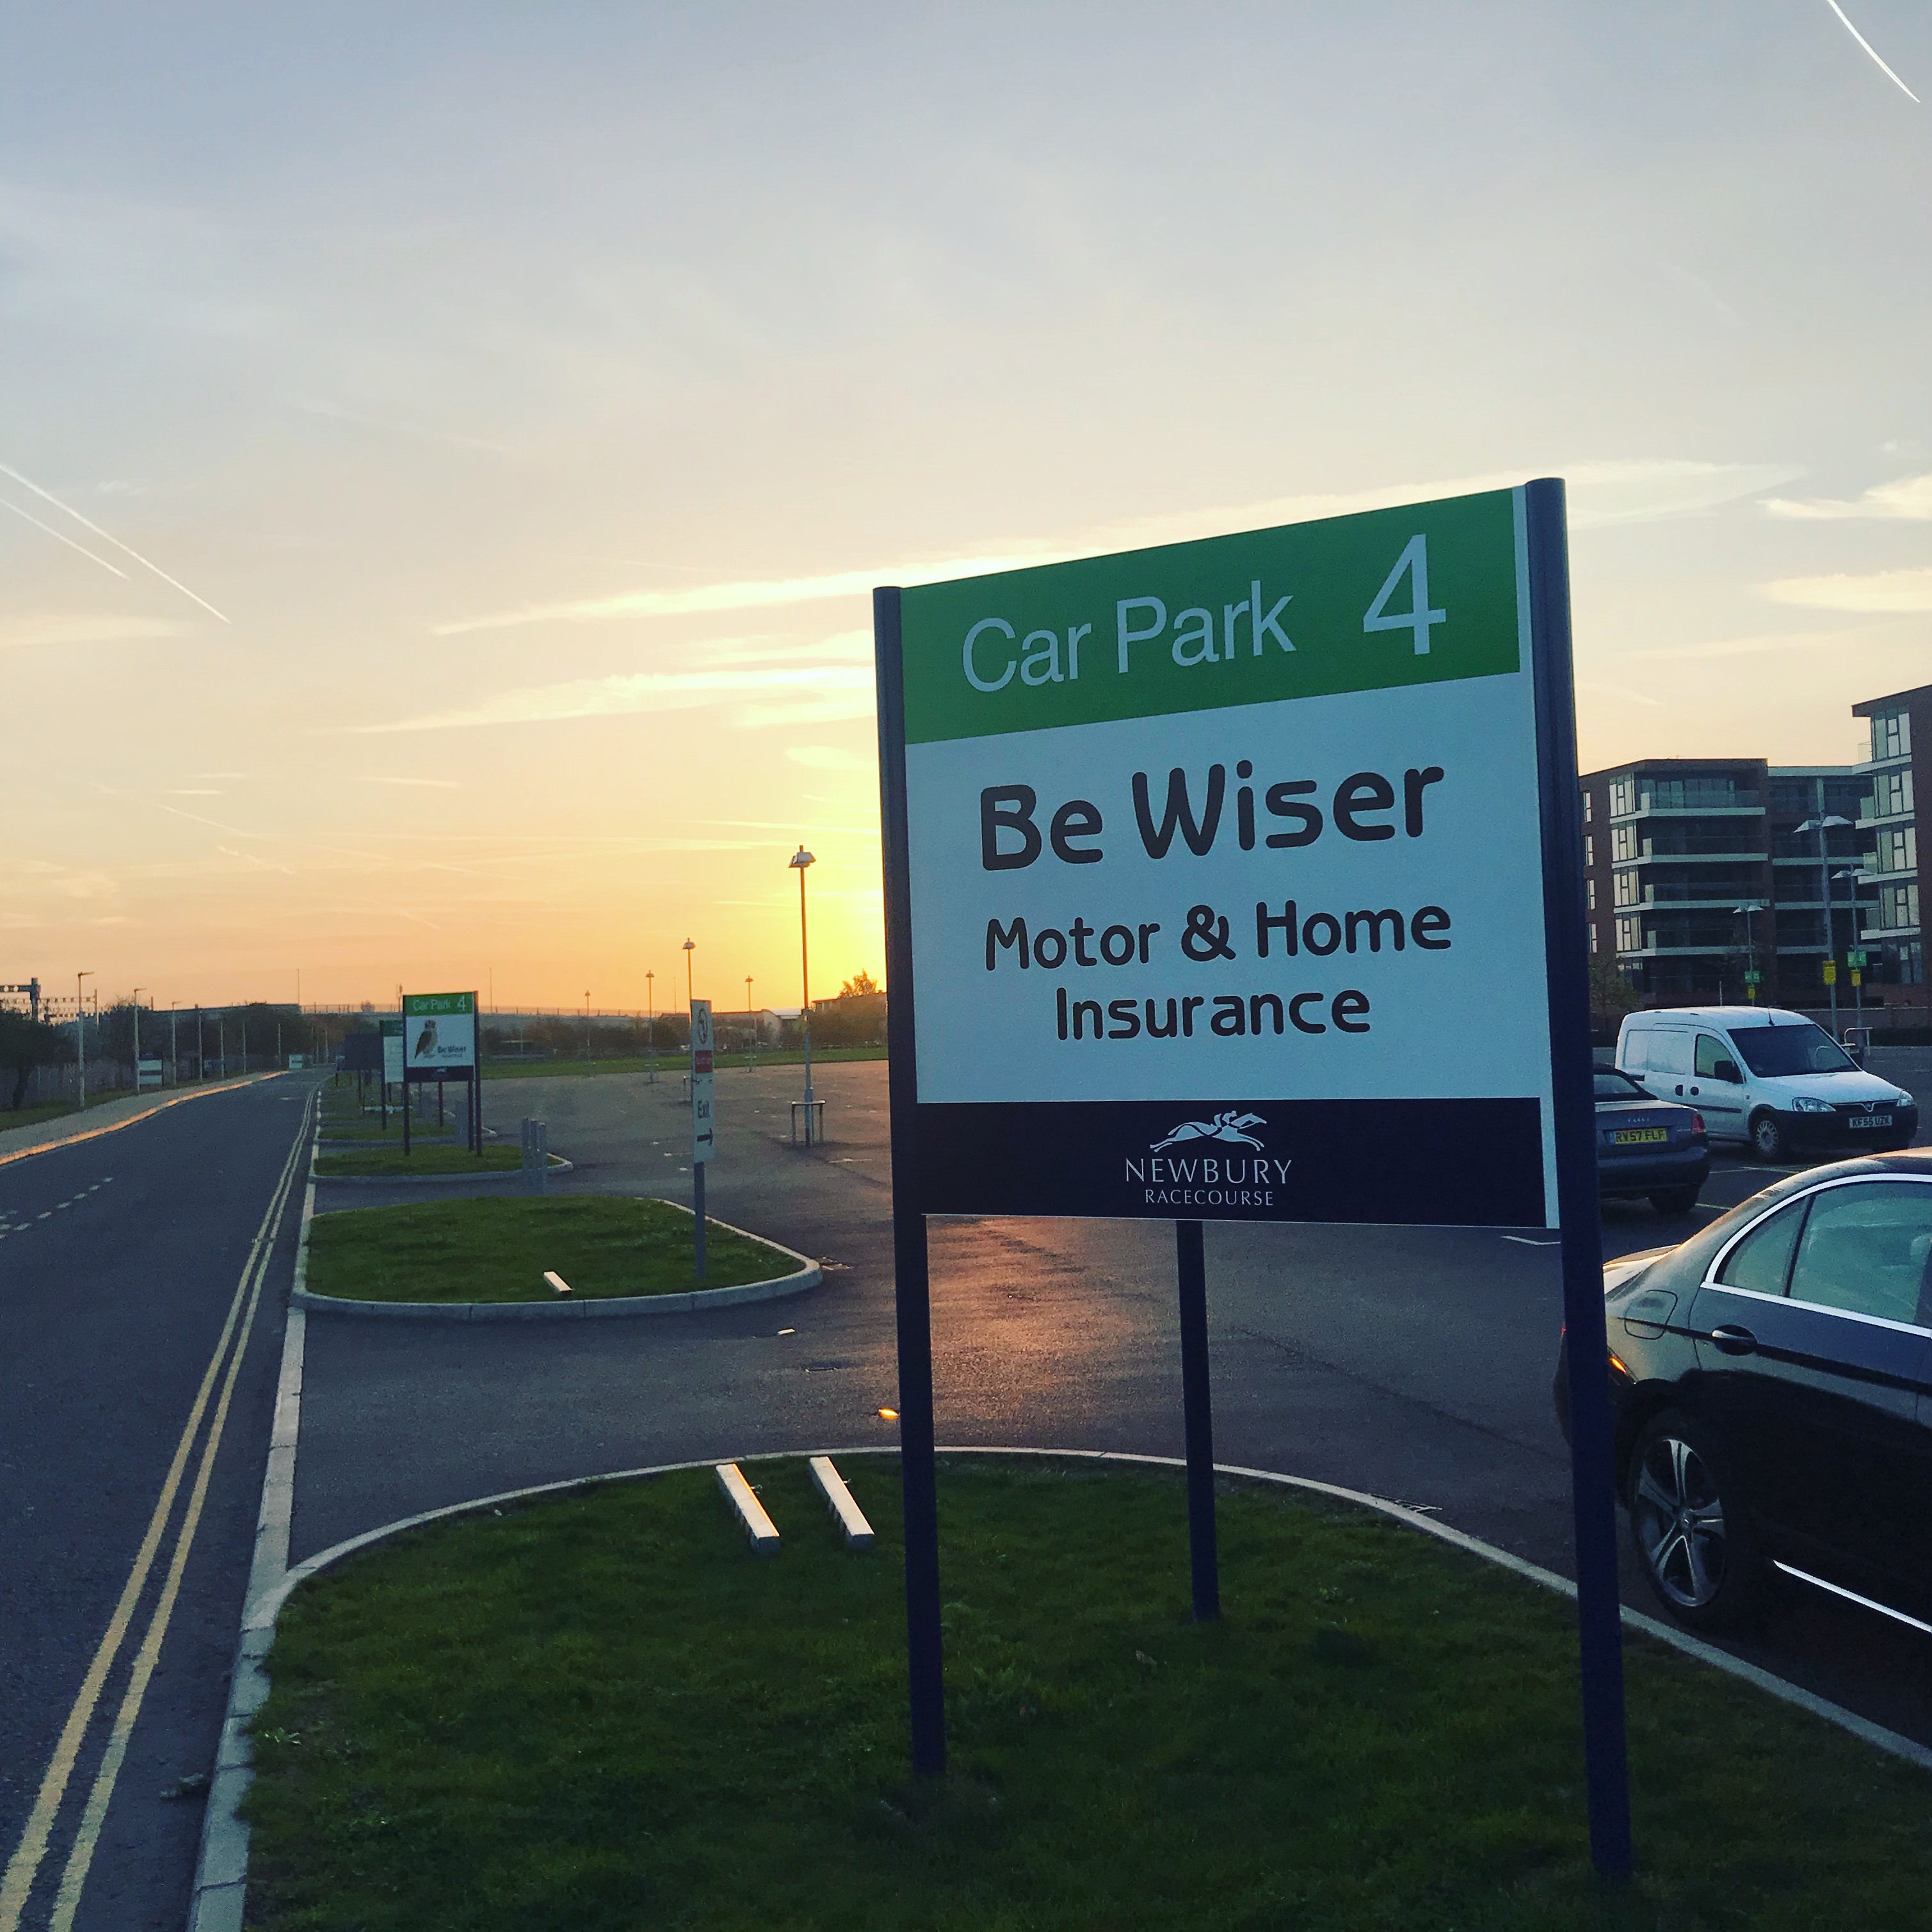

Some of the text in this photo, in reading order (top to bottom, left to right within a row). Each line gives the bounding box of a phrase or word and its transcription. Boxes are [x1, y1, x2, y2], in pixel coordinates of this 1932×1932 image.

[962, 533, 1447, 692] Car Park 4
[980, 760, 1444, 871] Be Wiser
[986, 900, 1452, 972] Motor & Home
[413, 995, 467, 1011] Car Park 4
[1056, 988, 1371, 1040] Insurance
[1125, 1157, 1292, 1185] NEWBURY
[1145, 1189, 1275, 1206] RACECOURSE
